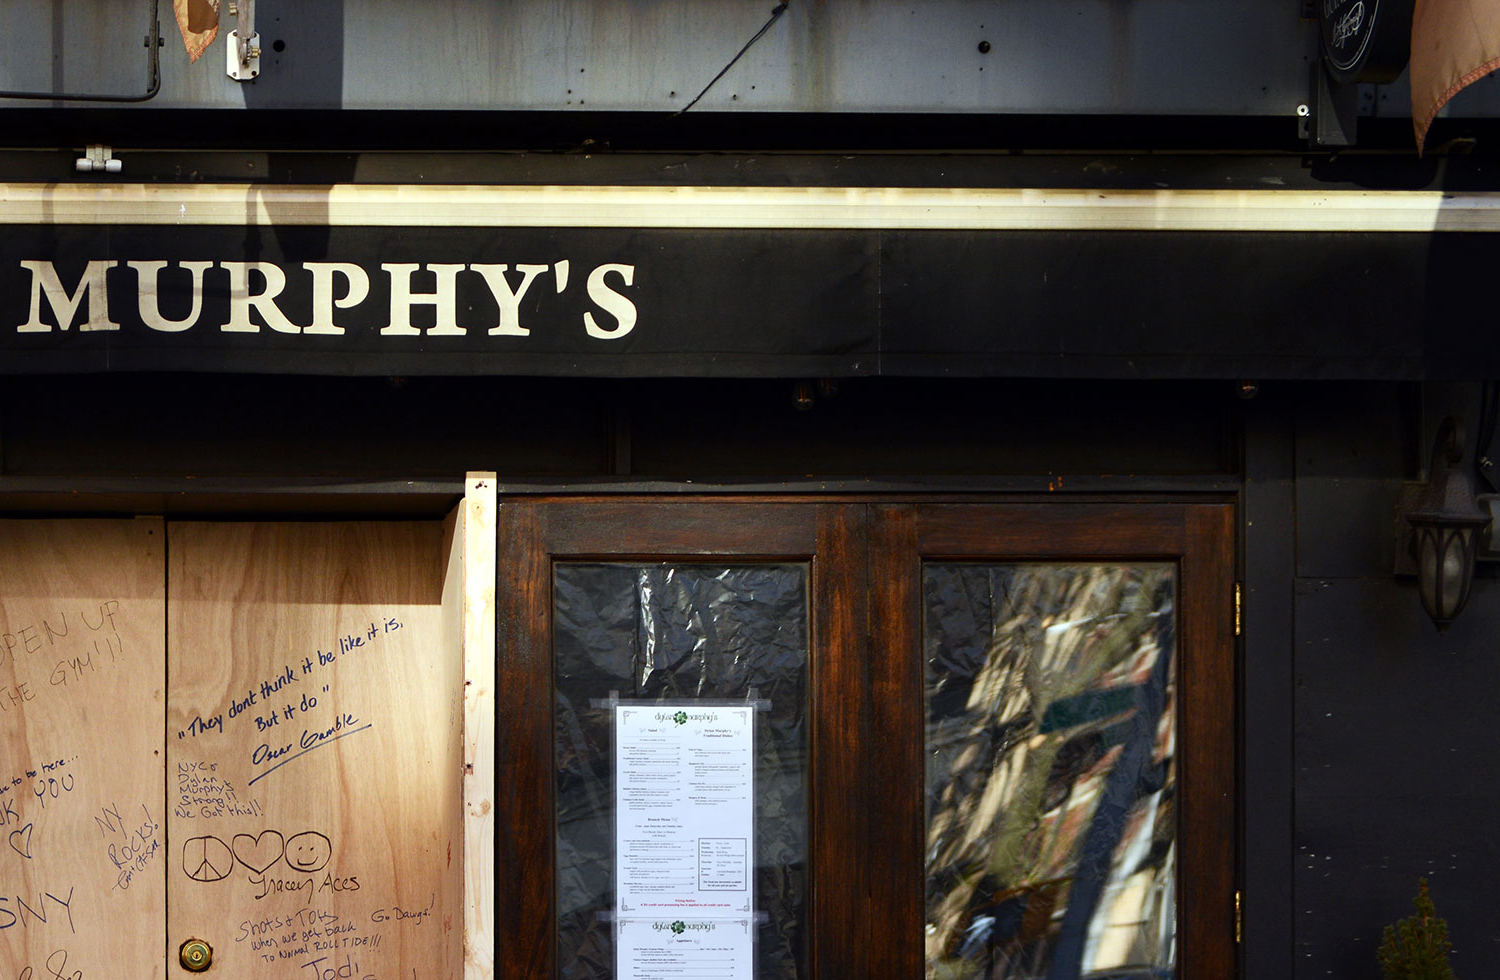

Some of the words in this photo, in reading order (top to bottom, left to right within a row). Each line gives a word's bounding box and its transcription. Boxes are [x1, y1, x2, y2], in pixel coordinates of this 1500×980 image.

[17, 259, 638, 341] MURPHY'S
[81, 600, 119, 631] UP
[260, 666, 299, 699] think
[302, 657, 313, 674] it
[318, 650, 335, 667] be
[339, 635, 365, 654] like
[367, 623, 378, 640] it
[255, 711, 279, 732] But
[284, 704, 296, 720] it
[252, 743, 292, 765] Oscar
[300, 713, 359, 749] Gamble
[12, 776, 22, 786] to
[25, 769, 37, 779] be
[33, 773, 74, 808] YOU
[178, 773, 217, 787] Dylan
[94, 802, 128, 838] NY
[175, 805, 196, 818] We
[201, 806, 222, 818] Got
[371, 910, 390, 922] Go
[282, 931, 297, 944] we
[302, 929, 321, 942] get
[325, 922, 356, 936] back
